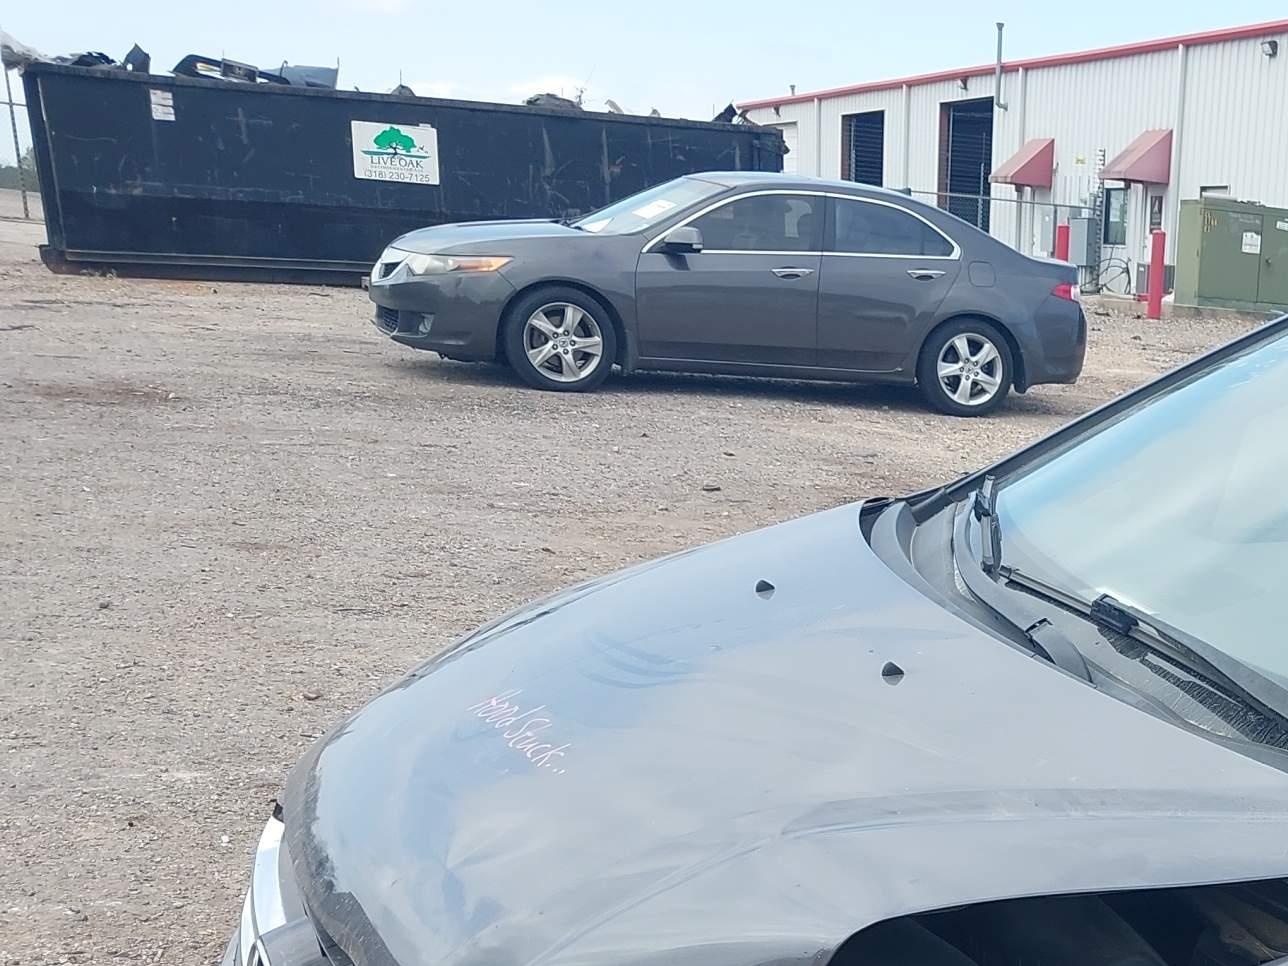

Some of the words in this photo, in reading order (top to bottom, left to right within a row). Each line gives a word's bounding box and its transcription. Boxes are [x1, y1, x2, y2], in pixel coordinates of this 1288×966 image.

[371, 156, 397, 166] LIVE
[399, 158, 424, 169] OAK
[389, 171, 430, 182] 230-7125
